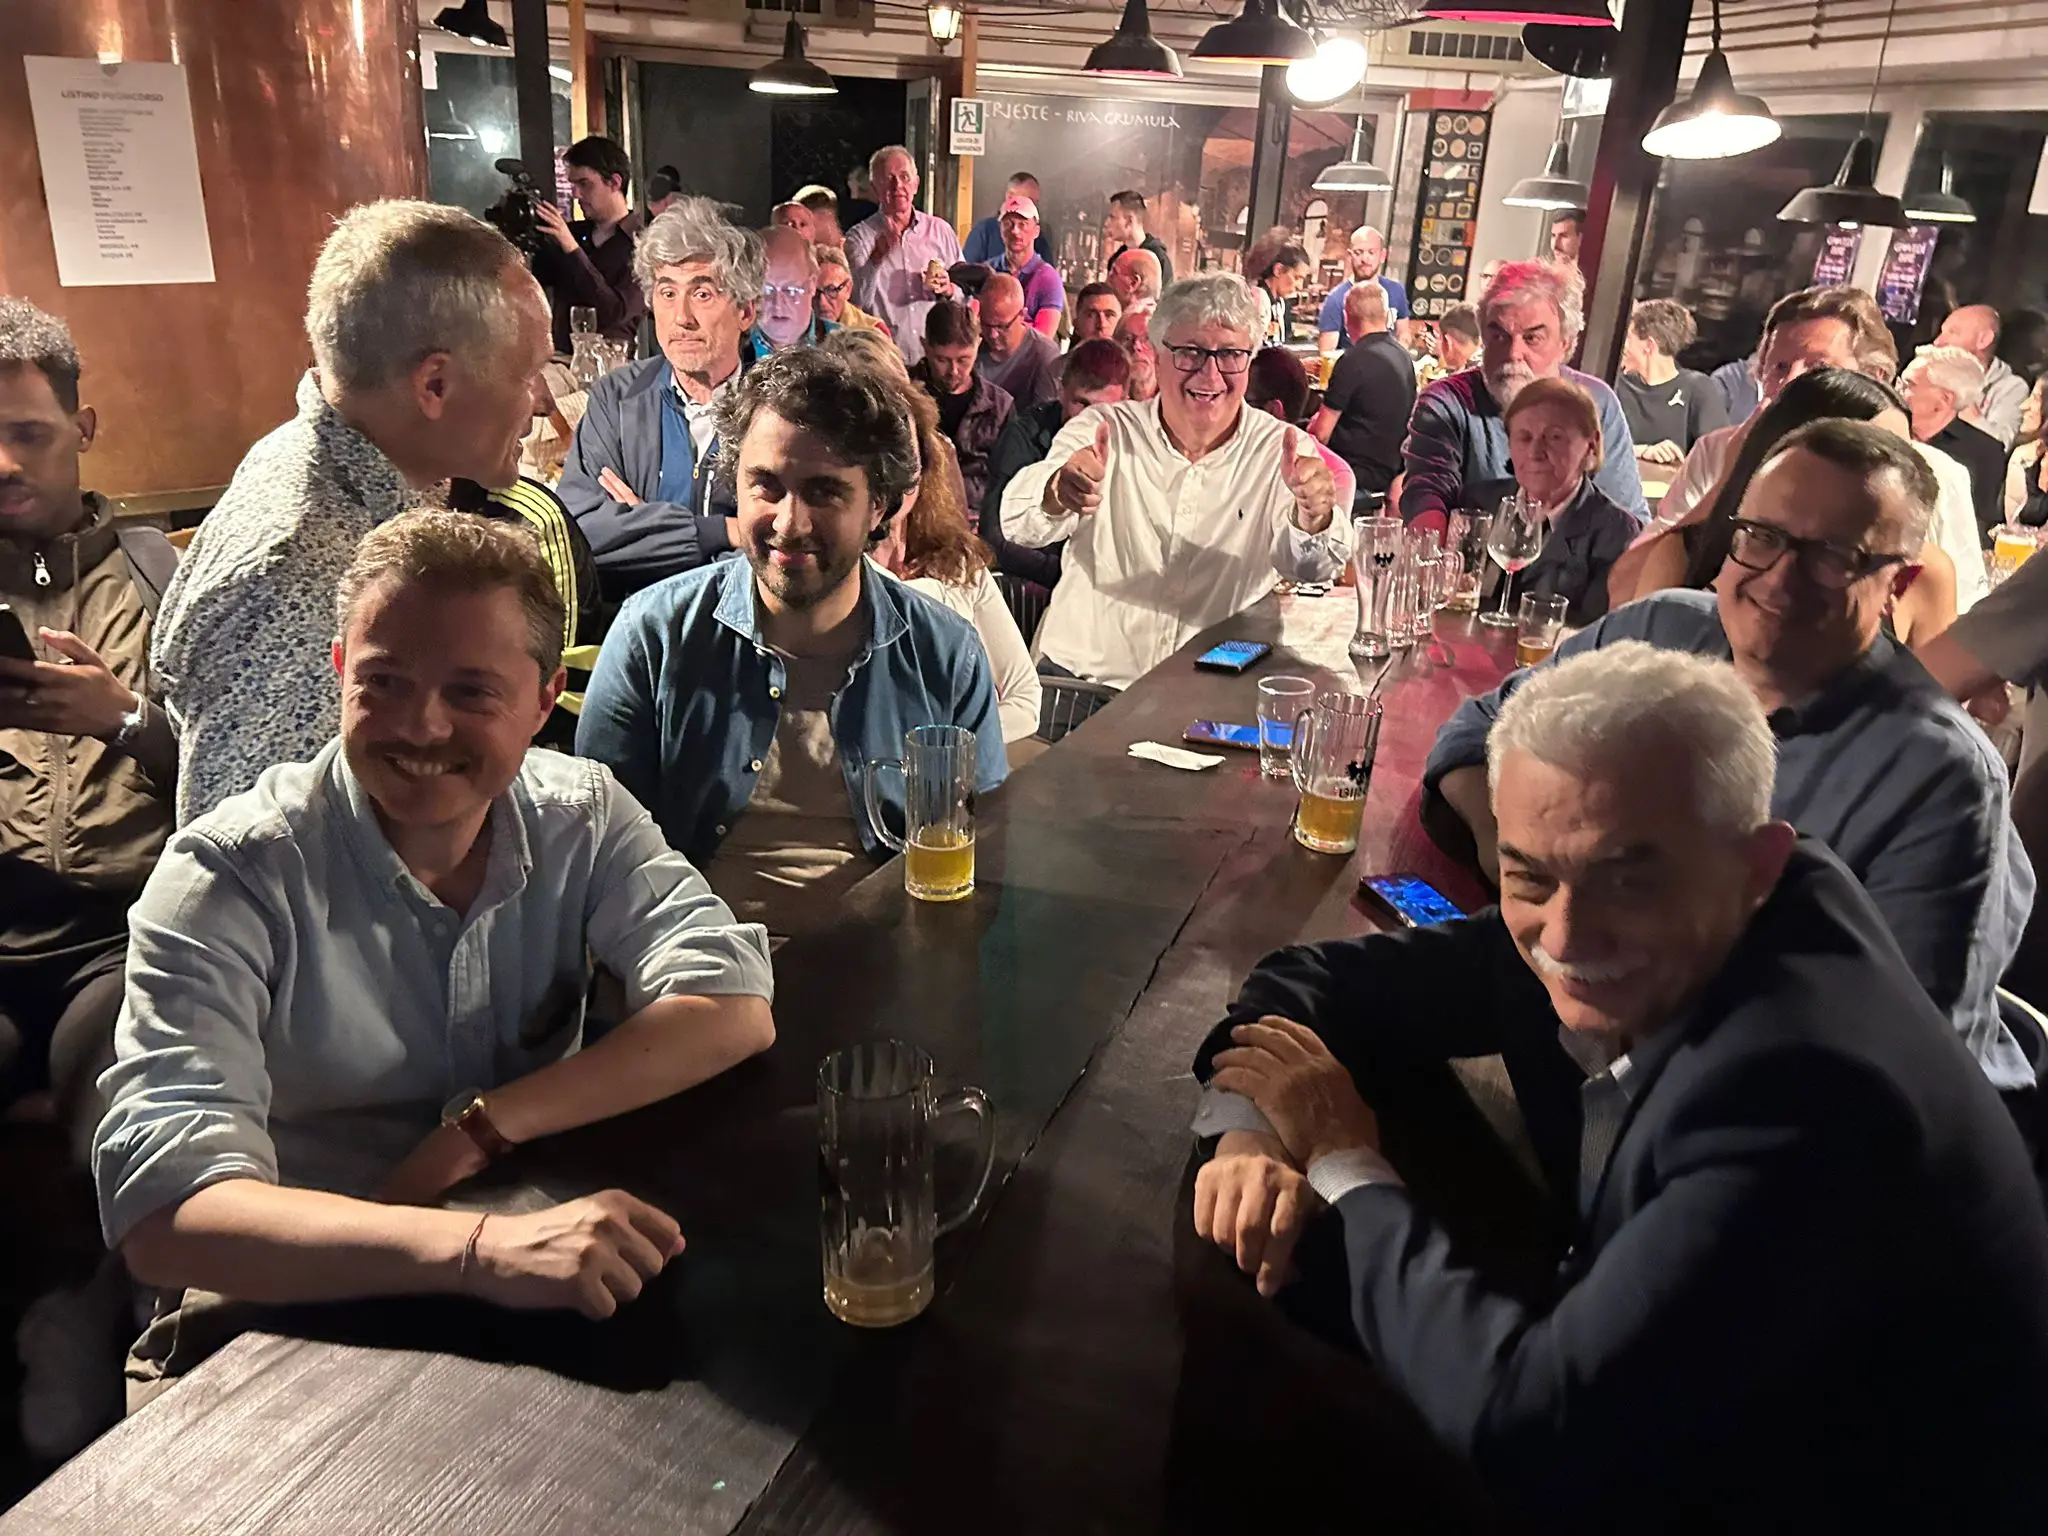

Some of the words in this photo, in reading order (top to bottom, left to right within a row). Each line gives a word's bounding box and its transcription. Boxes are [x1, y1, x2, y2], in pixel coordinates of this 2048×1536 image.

[61, 89, 100, 100] LISTINO
[101, 91, 164, 102] CORSO
[1066, 110, 1102, 124] RIVA
